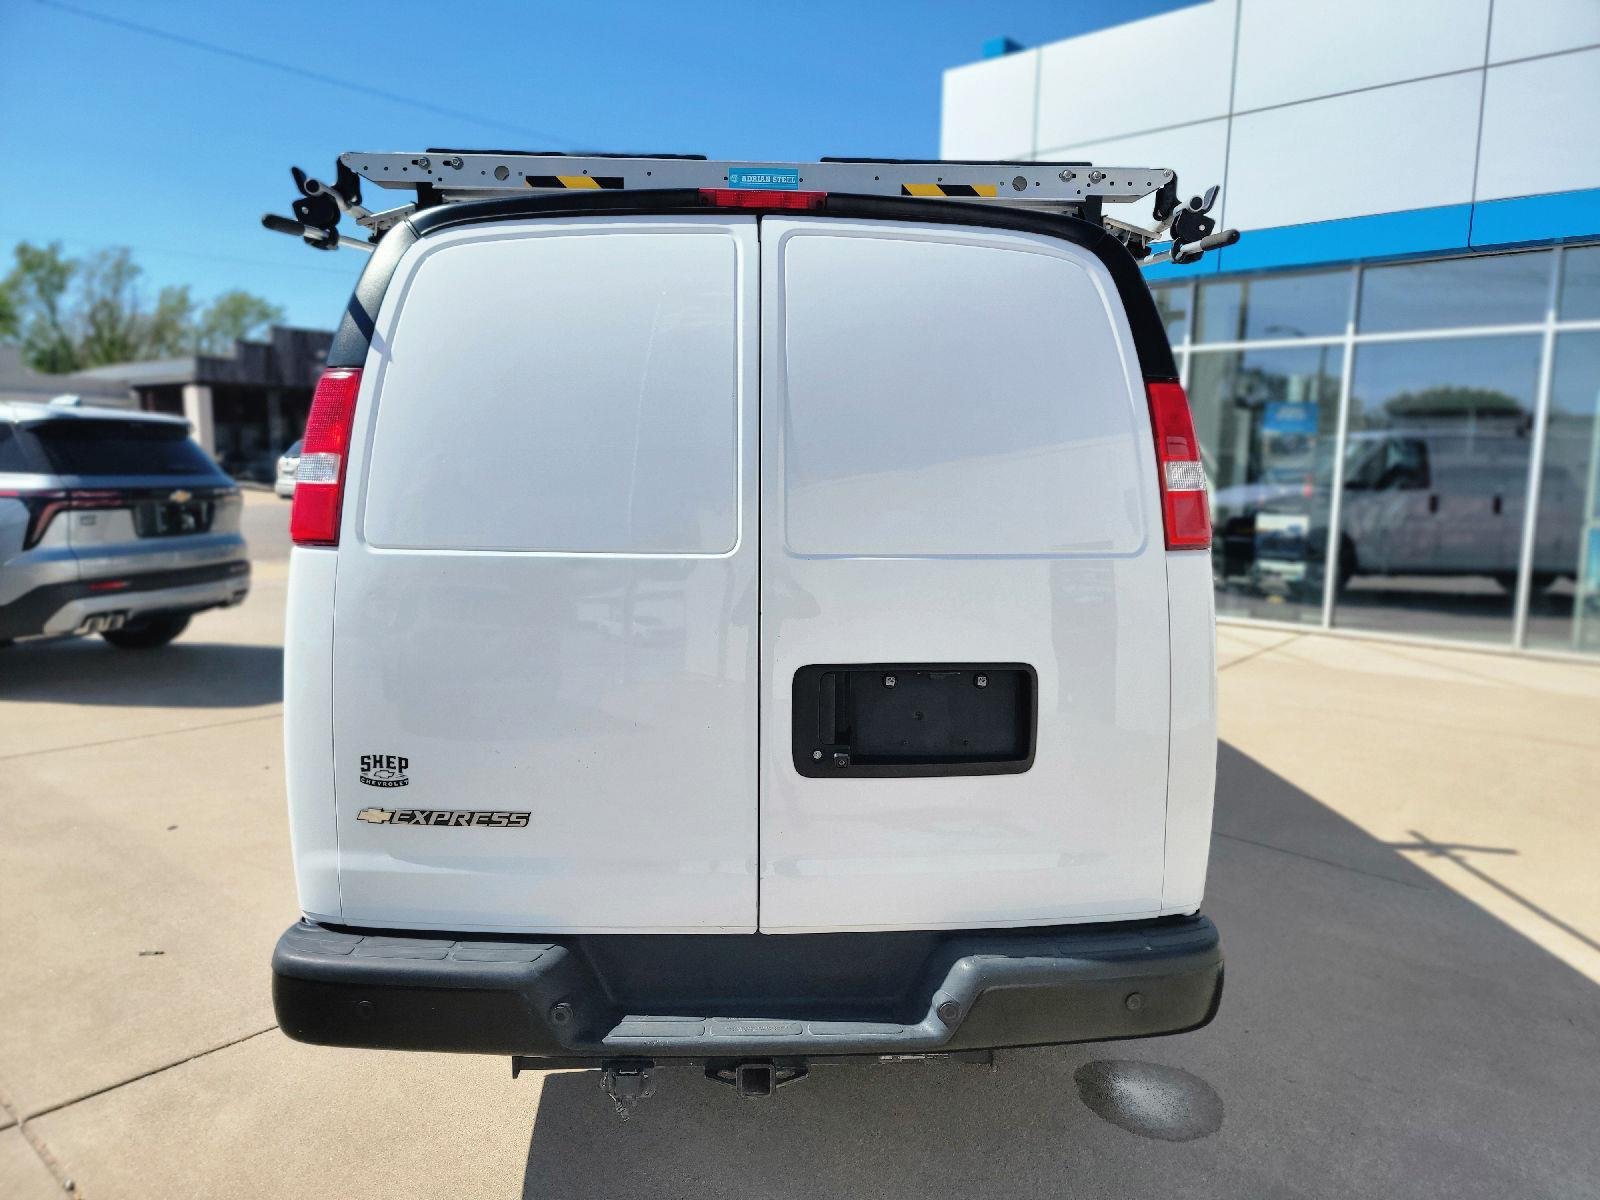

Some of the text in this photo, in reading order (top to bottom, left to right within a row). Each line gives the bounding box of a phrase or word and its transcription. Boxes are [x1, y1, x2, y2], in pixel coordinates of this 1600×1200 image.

[741, 175, 796, 184] ADRIAN STEEL
[360, 754, 409, 773] SHEP
[360, 777, 409, 787] CHEVROLET
[390, 810, 531, 827] EXPRESS
